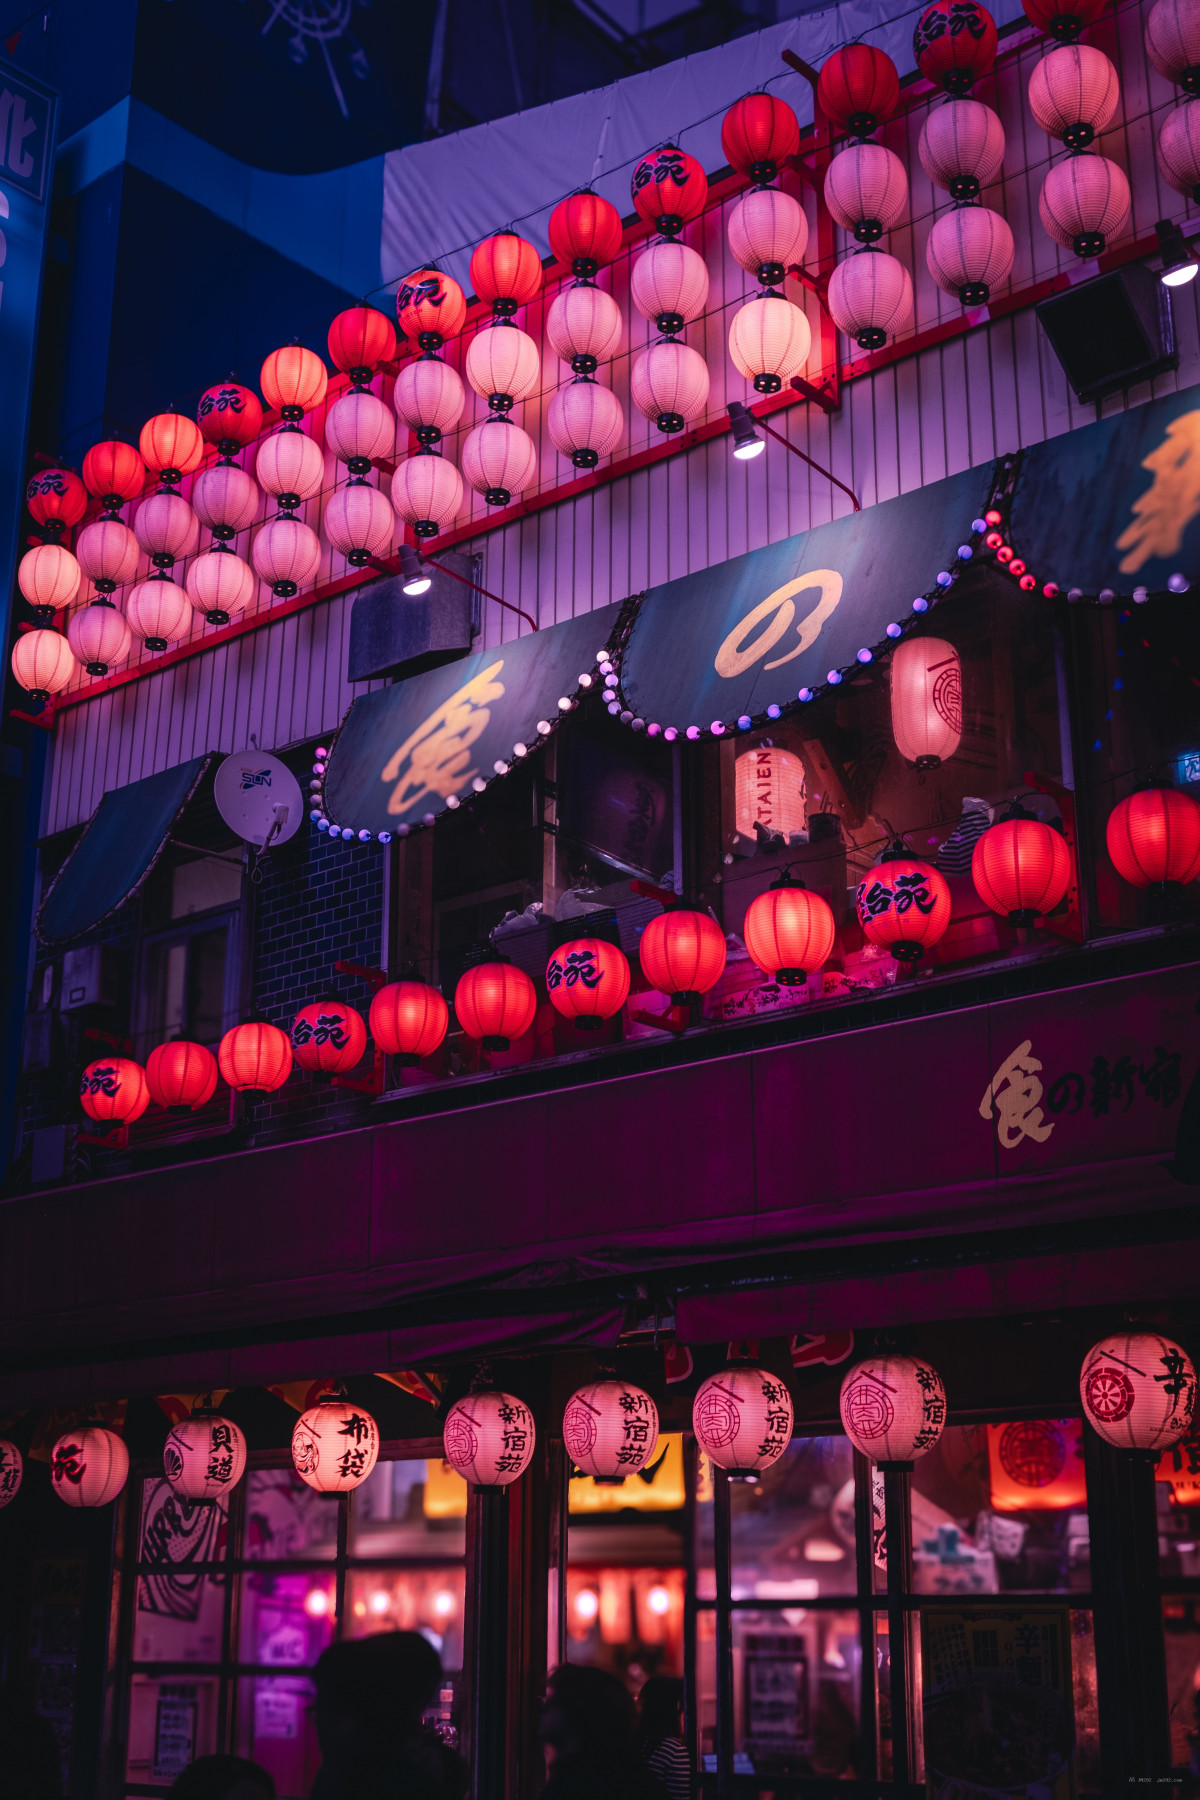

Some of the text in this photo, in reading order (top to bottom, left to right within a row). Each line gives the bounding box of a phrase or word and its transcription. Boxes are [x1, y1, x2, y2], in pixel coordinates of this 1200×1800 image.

[714, 569, 843, 678] の
[241, 772, 272, 787] SUN
[495, 1403, 527, 1473] 新宿苑
[615, 1392, 650, 1466] 新宿苑
[758, 1381, 790, 1458] 新宿苑
[912, 1367, 947, 1450] 新宿苑
[204, 1424, 235, 1483] 貝道
[337, 1413, 369, 1478] 布袋
